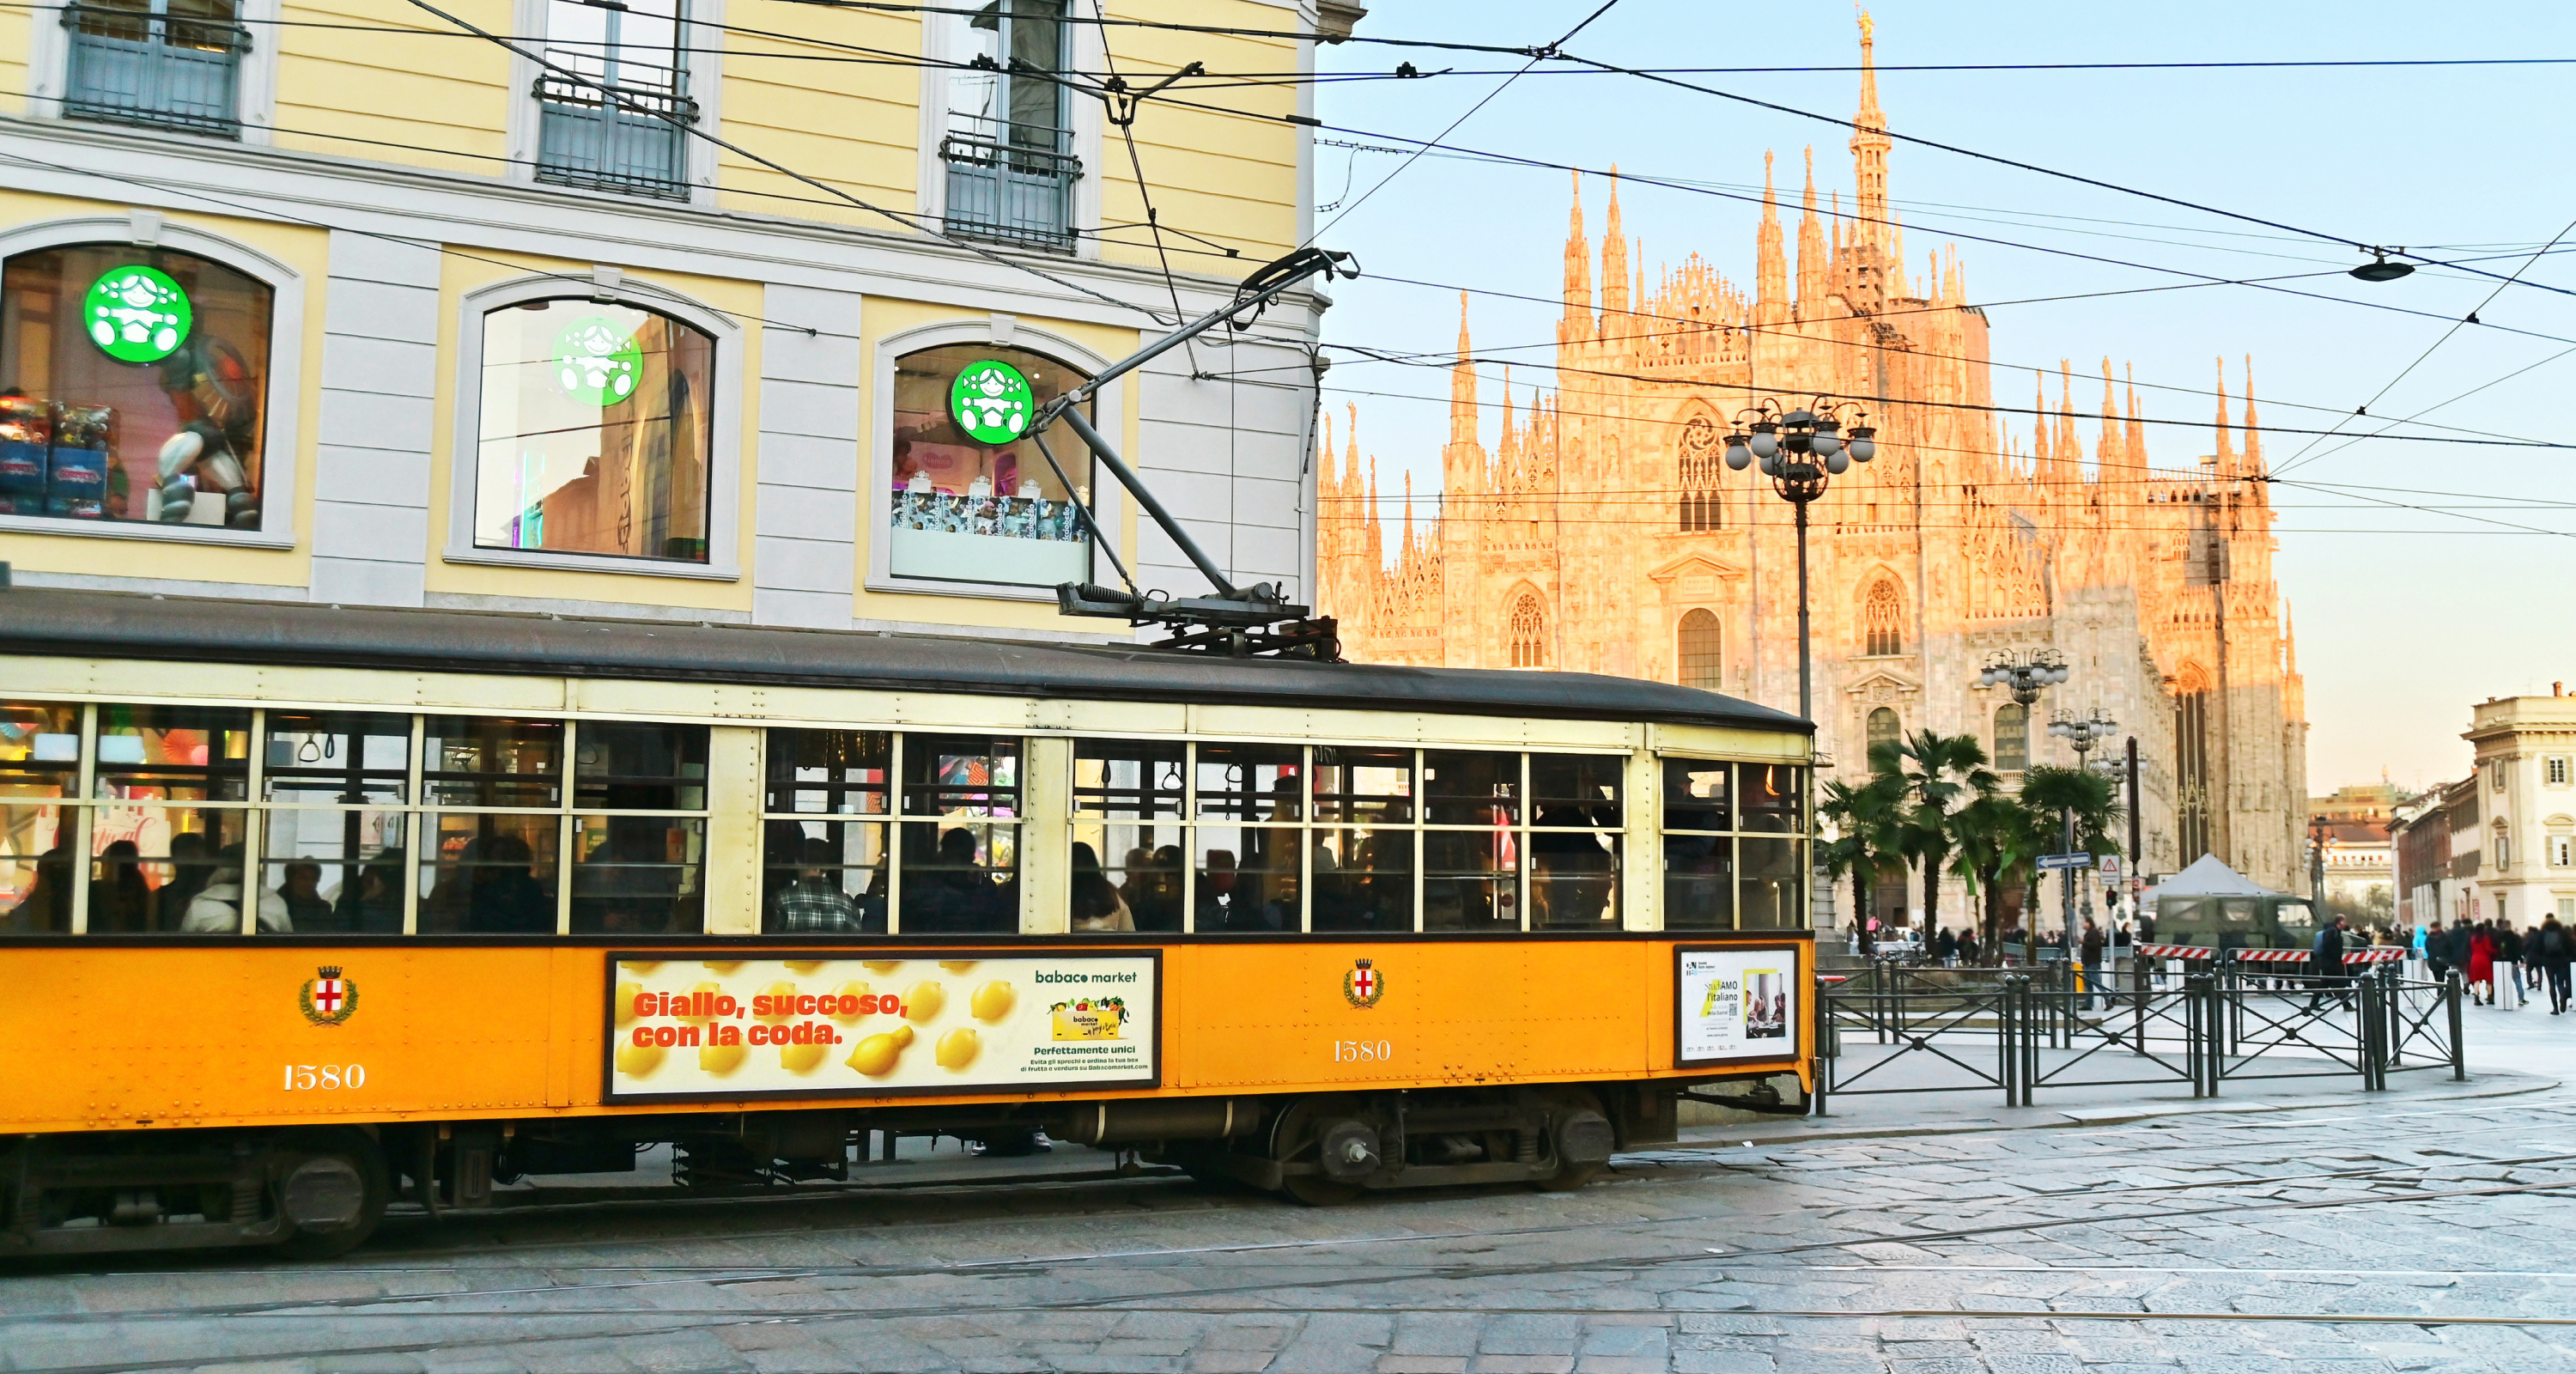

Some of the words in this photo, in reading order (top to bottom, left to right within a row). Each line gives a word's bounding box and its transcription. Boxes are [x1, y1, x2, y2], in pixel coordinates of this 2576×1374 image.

[1036, 970, 1088, 982] babaco
[1091, 972, 1137, 982] market
[633, 992, 745, 1019] Giallo,
[752, 994, 908, 1018] succoso,
[1707, 993, 1738, 1001] l'italiano
[632, 1026, 700, 1048] con
[708, 1022, 740, 1047] la
[748, 1021, 842, 1047] coda.
[1034, 1047, 1109, 1055] Perfettamente
[1111, 1045, 1135, 1054] unici
[1334, 1040, 1391, 1062] 1580
[284, 1064, 366, 1091] 1580
